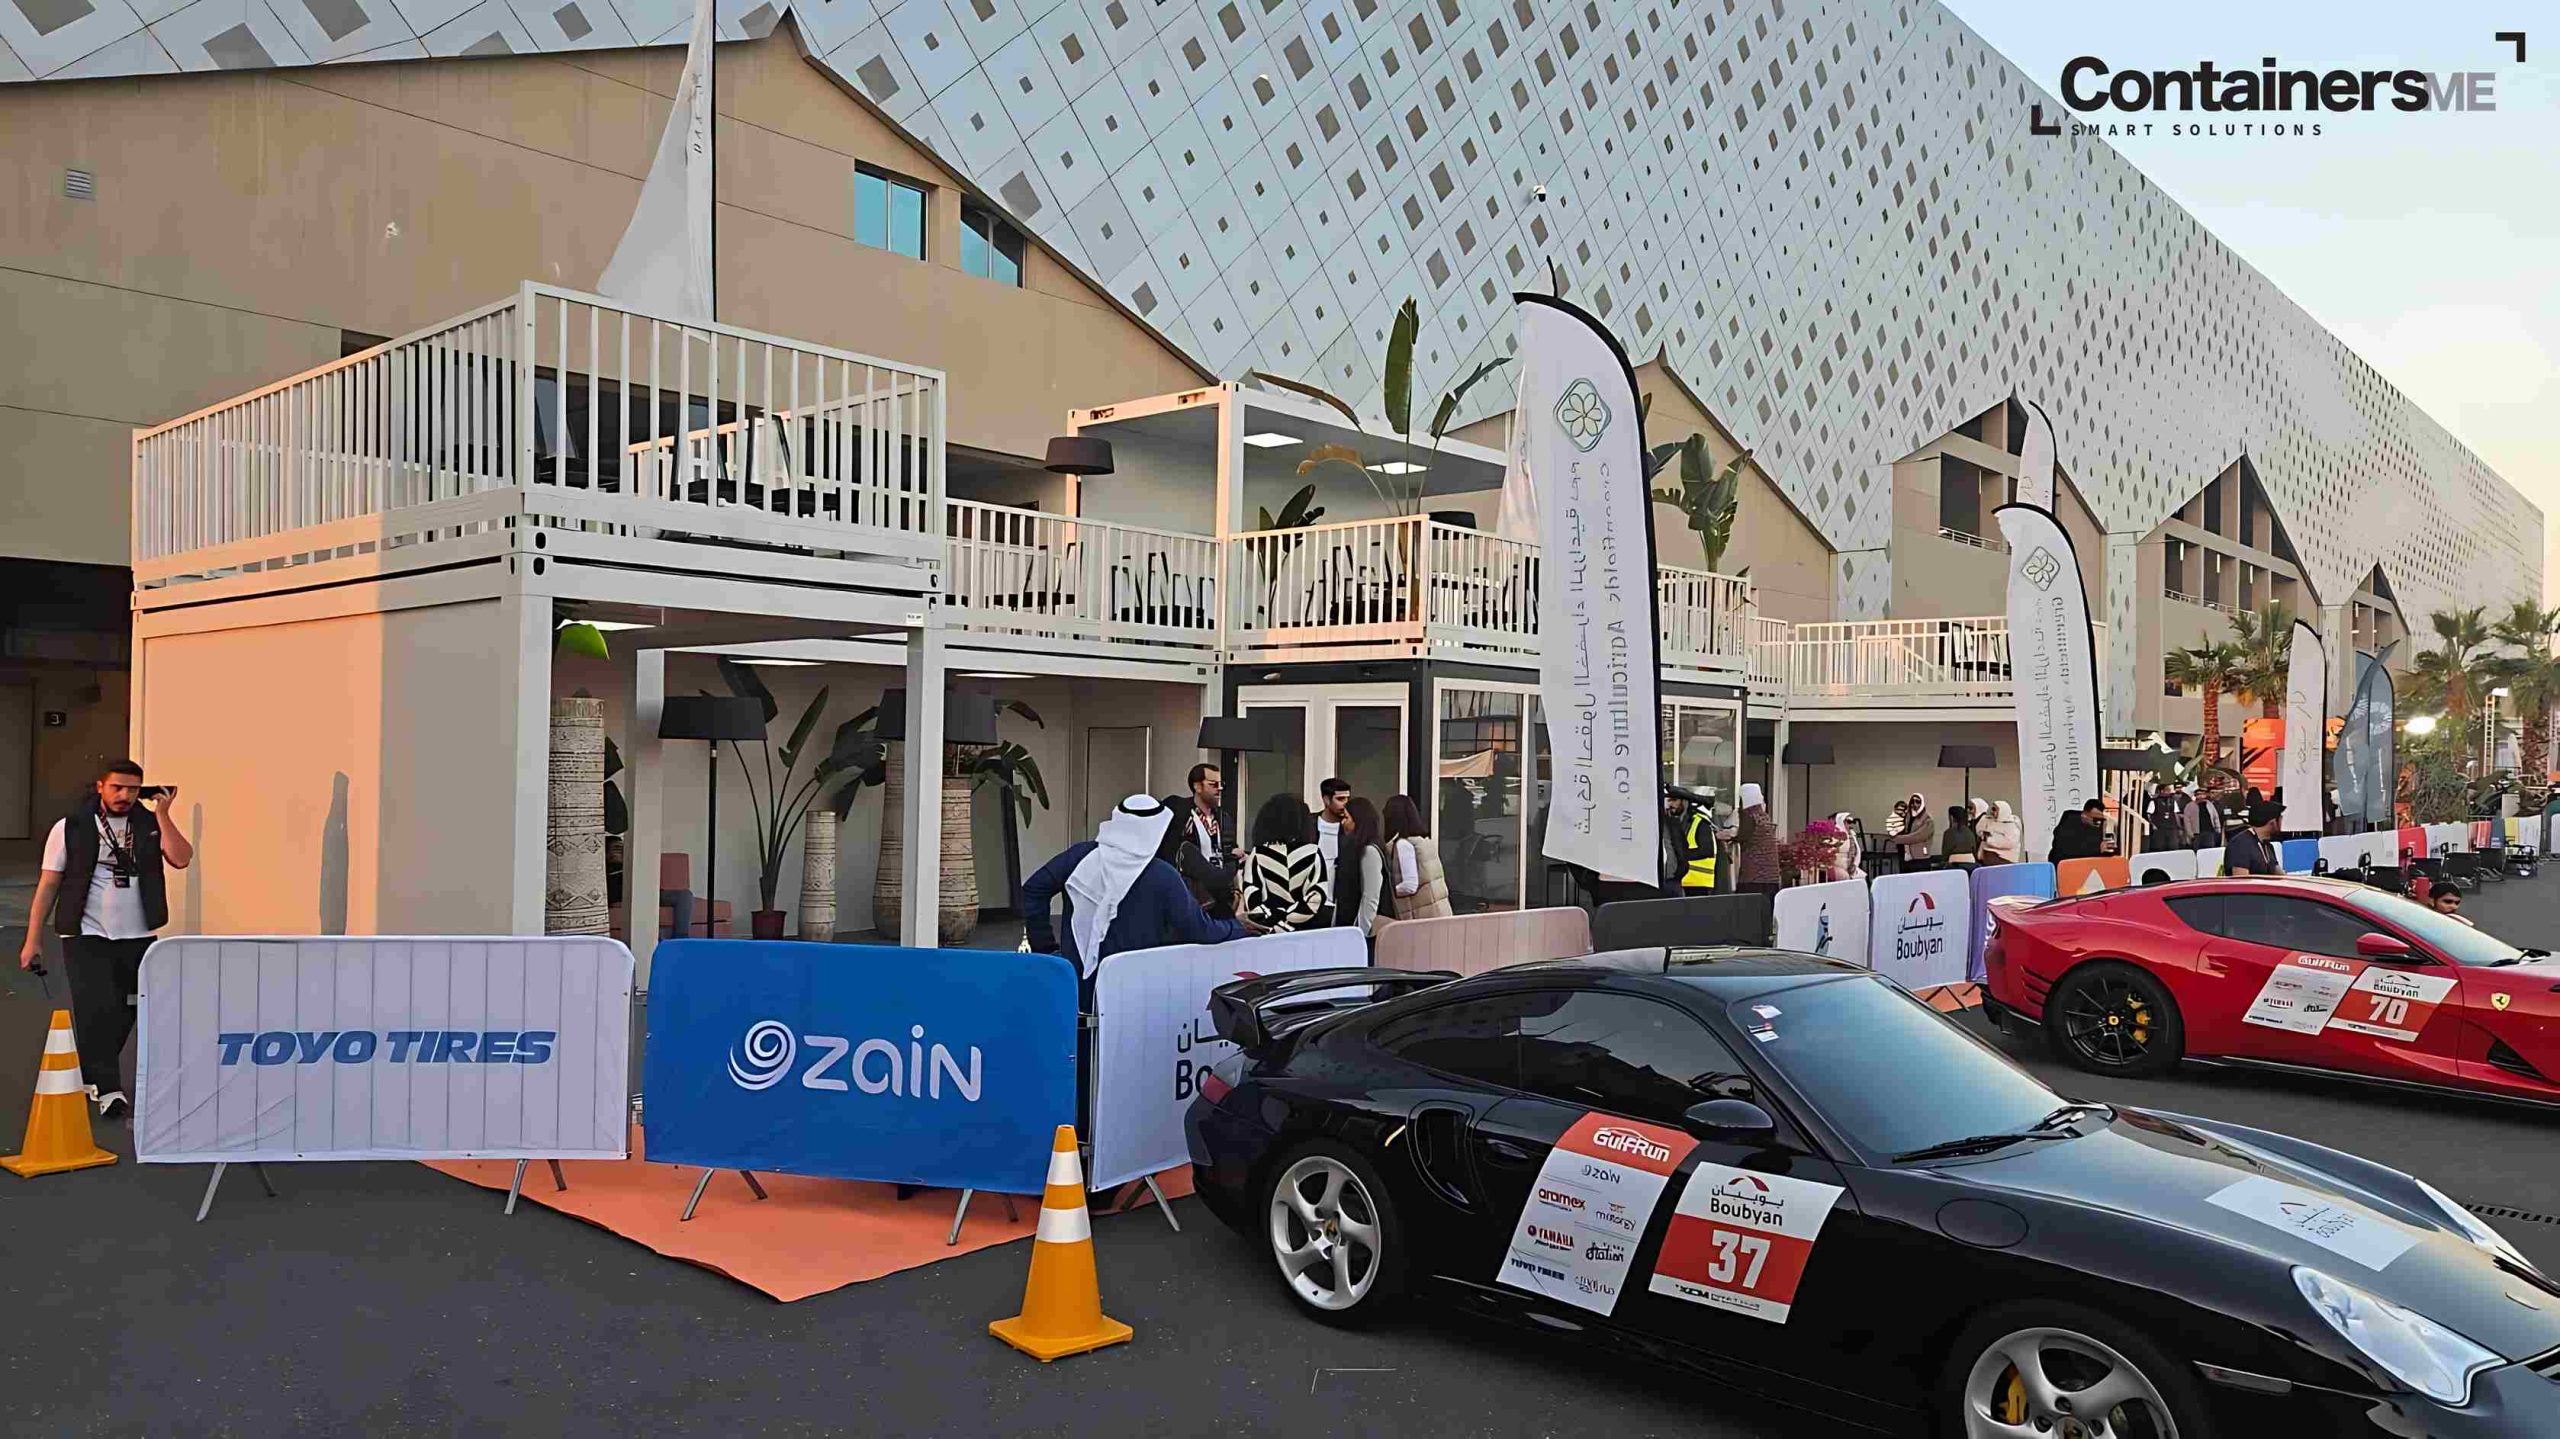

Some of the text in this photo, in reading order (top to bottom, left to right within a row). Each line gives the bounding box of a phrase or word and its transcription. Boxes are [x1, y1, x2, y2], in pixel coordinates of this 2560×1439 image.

[1896, 935, 1943, 961] Boubyan
[2368, 995, 2410, 1025] 70
[217, 1031, 556, 1065] TOYO TIRES
[1710, 1197, 1783, 1227] Boubyan
[1708, 1229, 1771, 1289] 37
